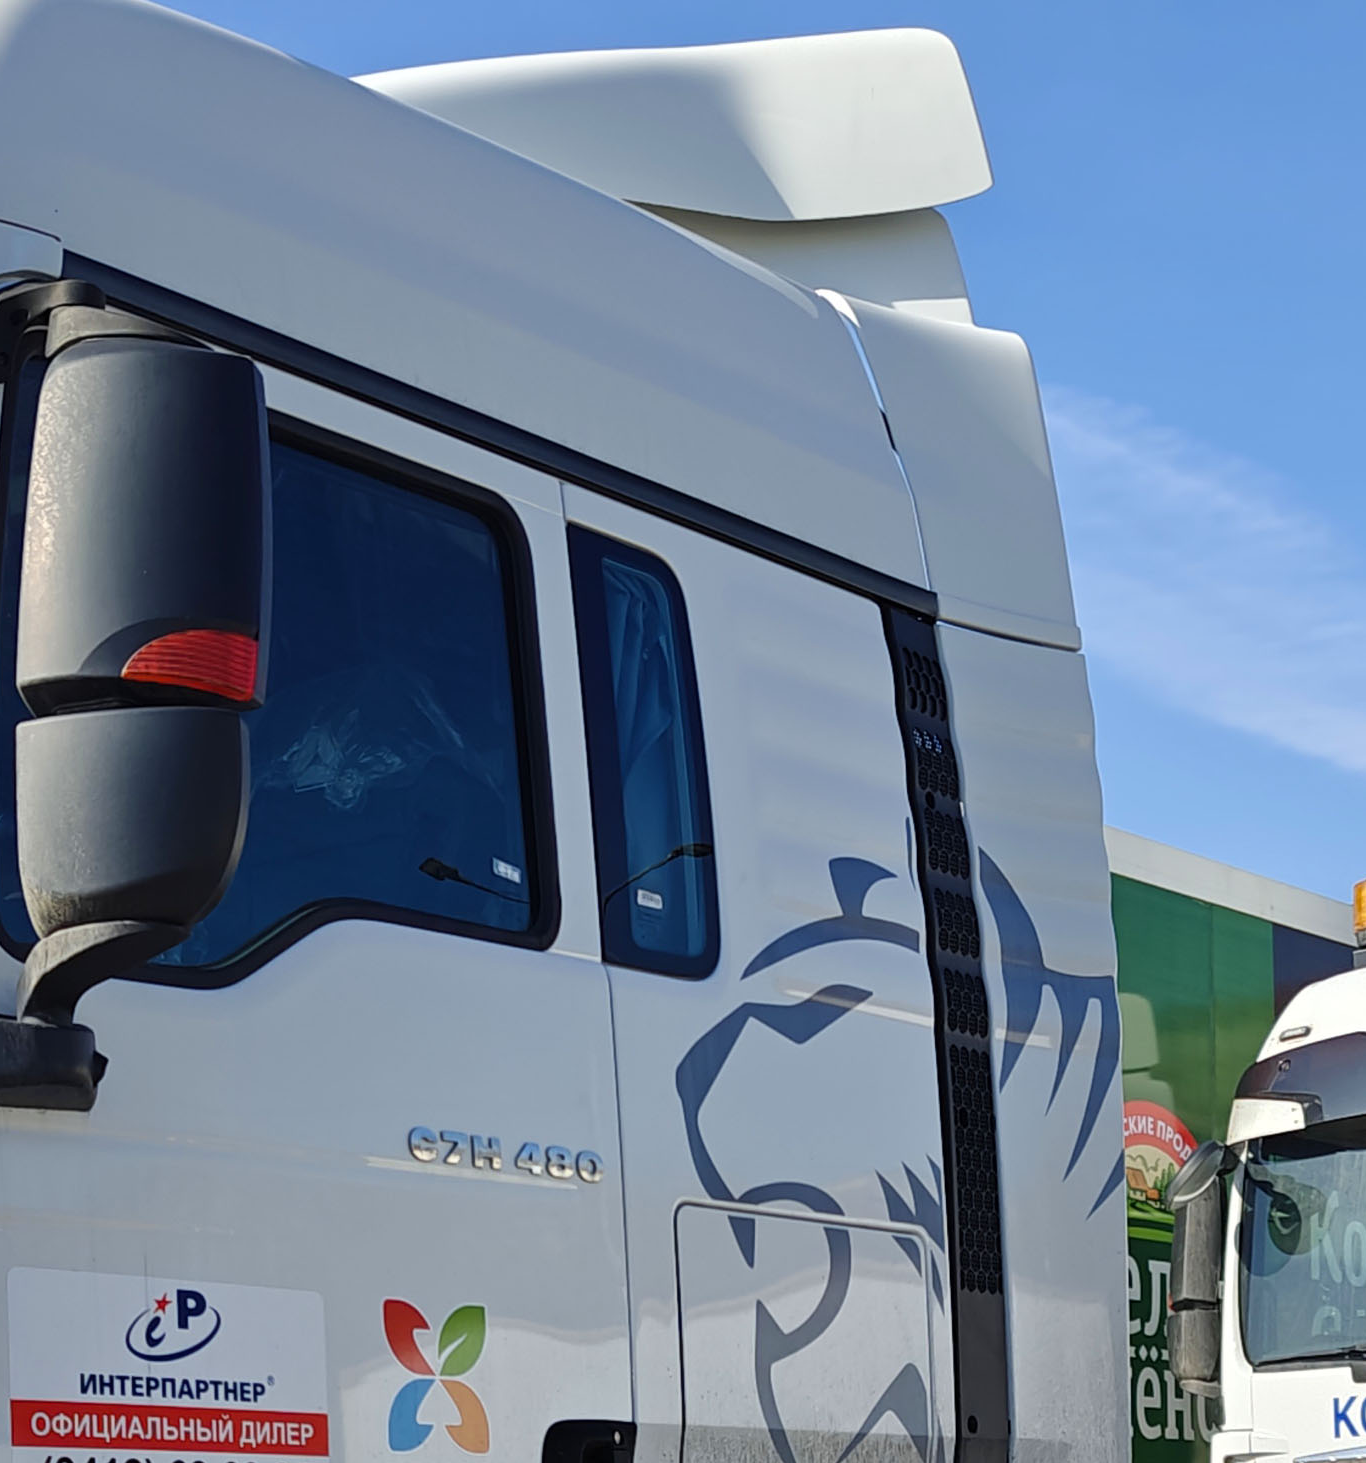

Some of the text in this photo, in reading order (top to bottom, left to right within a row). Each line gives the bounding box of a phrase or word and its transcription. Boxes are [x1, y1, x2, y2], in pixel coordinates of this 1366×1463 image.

[514, 1141, 604, 1184] 480
[30, 1411, 314, 1448] ОФИЦИАЛЬНЫЙ ДИЛЕР
